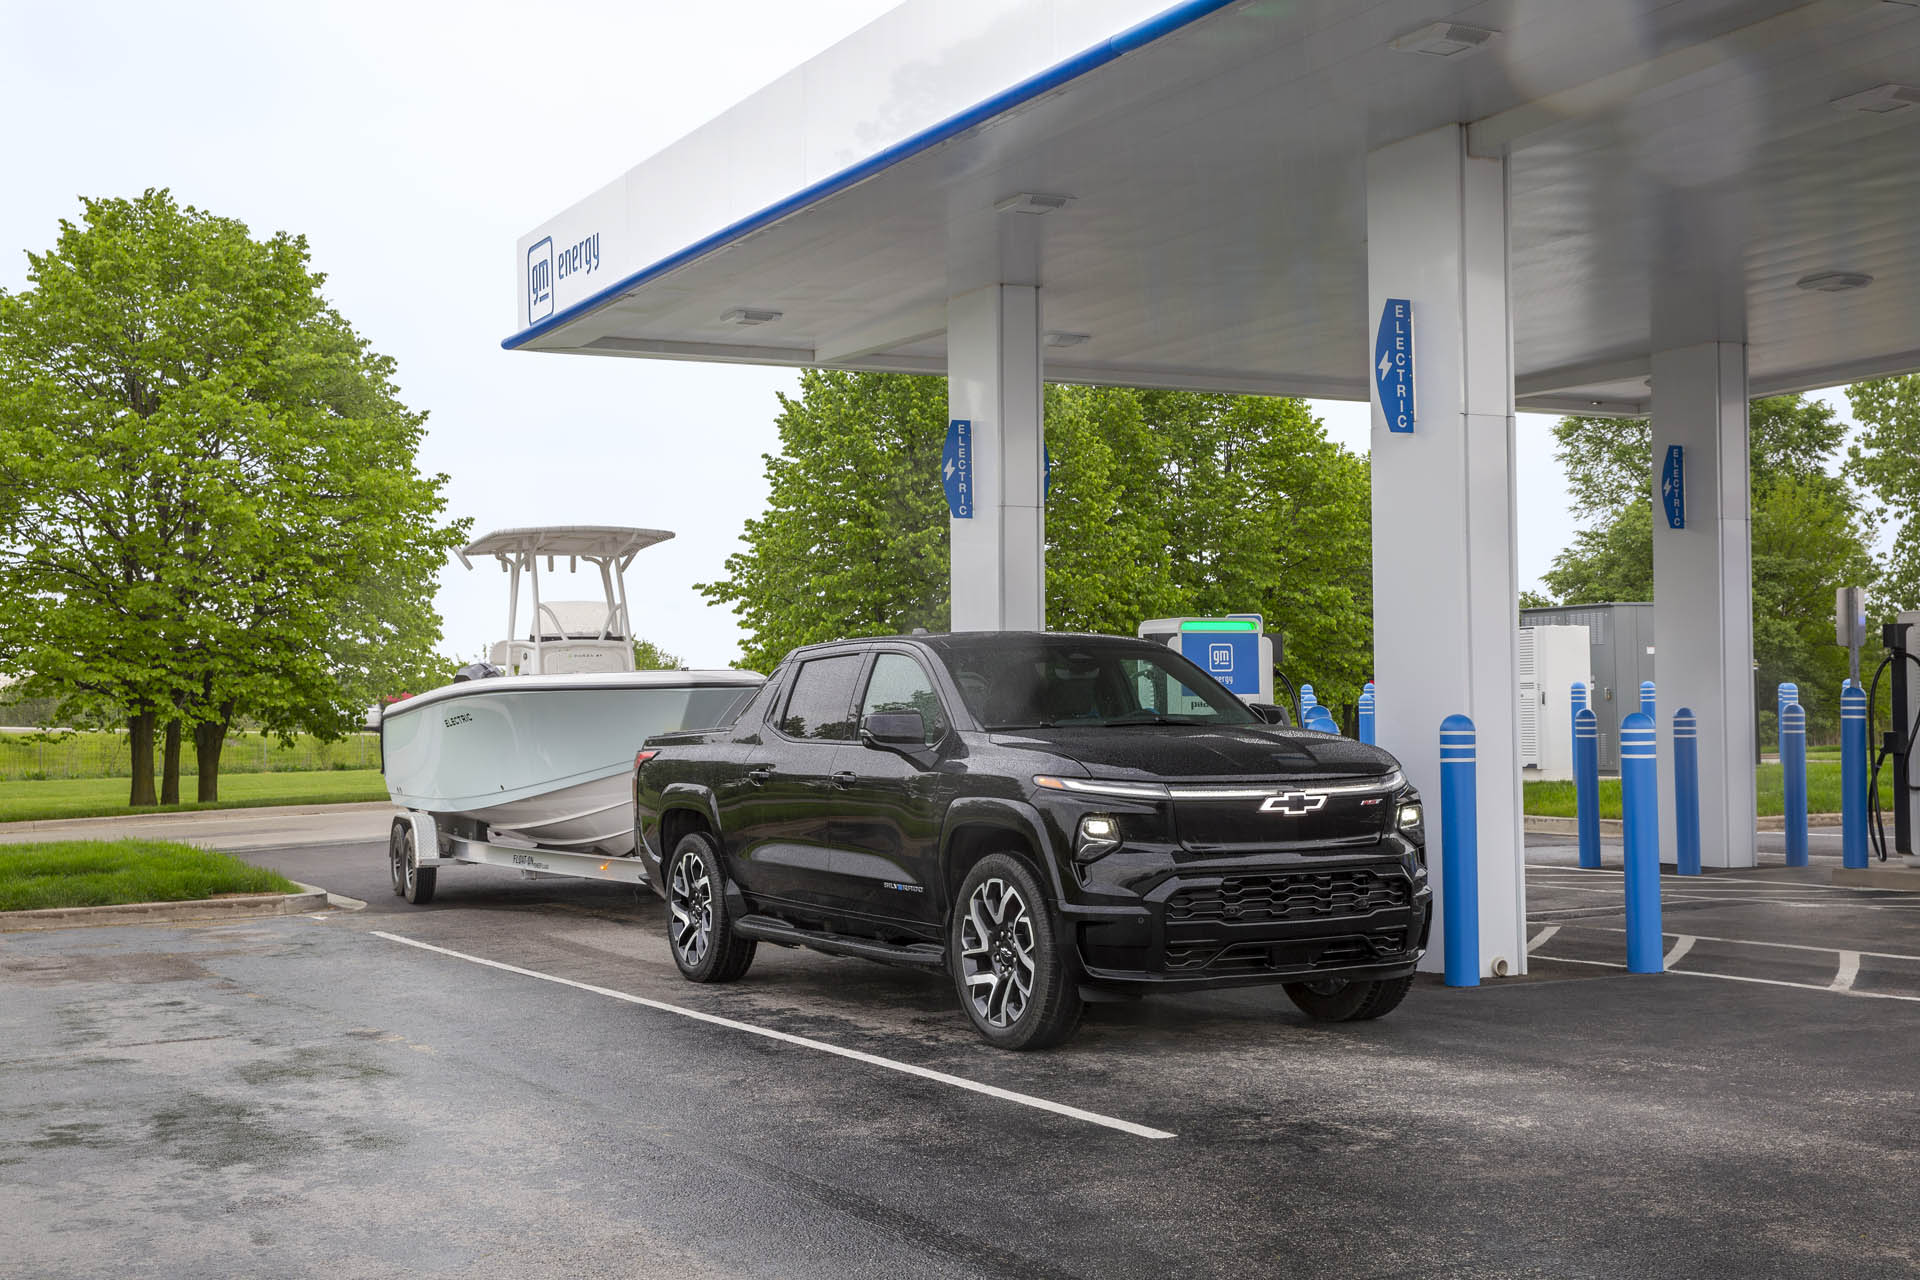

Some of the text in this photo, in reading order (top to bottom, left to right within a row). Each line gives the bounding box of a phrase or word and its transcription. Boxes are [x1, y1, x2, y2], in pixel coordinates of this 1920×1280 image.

[532, 232, 599, 305] gm energy
[1395, 304, 1407, 428] ELECTRIC
[958, 424, 967, 515] ELECTRIC
[1213, 650, 1229, 664] gm
[1214, 675, 1233, 685] nergy
[444, 713, 473, 728] ELECTRIC
